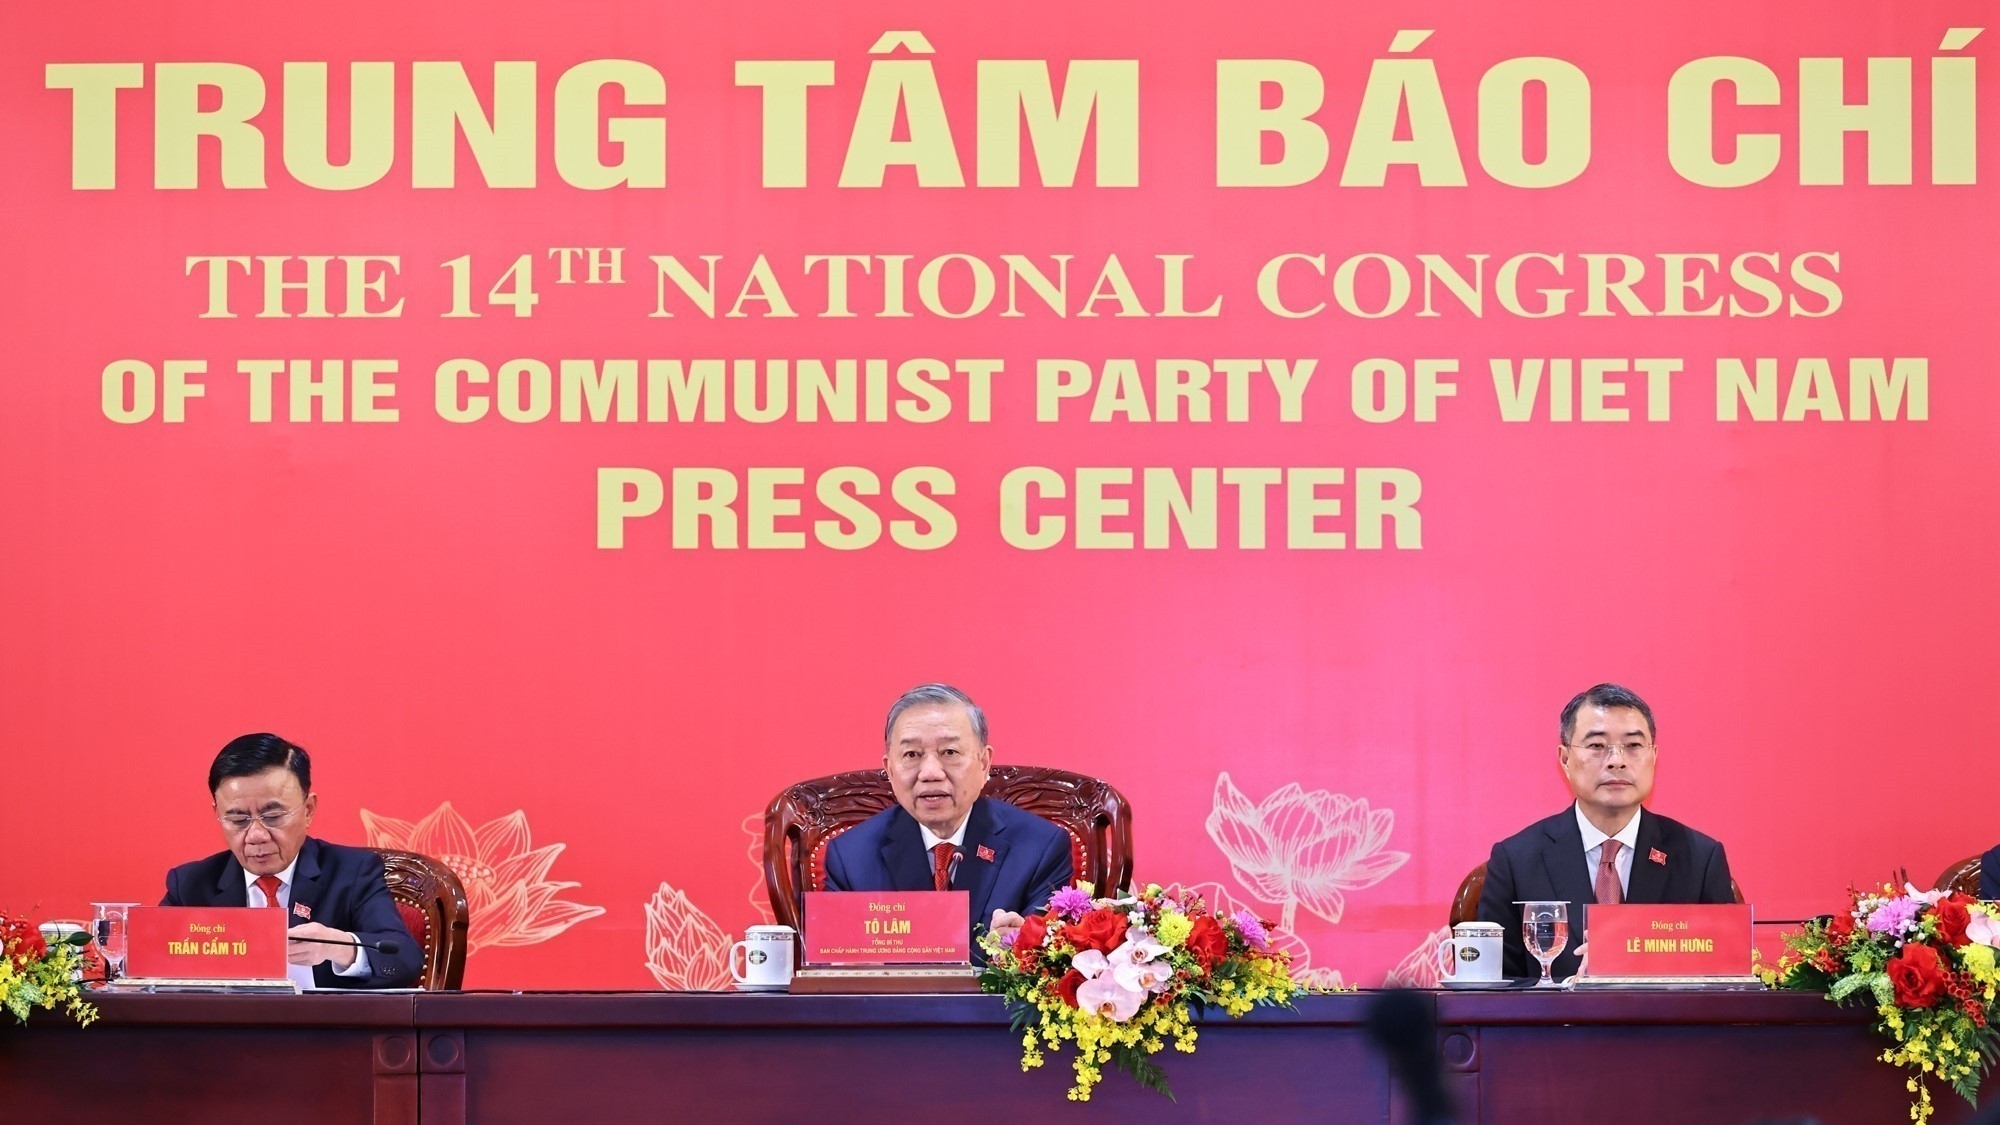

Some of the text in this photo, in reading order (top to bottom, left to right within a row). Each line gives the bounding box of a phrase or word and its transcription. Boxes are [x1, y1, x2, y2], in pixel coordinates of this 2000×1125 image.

[45, 28, 1985, 191] TRUNG TÂM BÁO CHÍ
[186, 255, 405, 319] THE
[649, 254, 1223, 319] NATIONAL
[1257, 253, 1844, 318] CONGRESS
[102, 358, 1929, 424] OF THE COMMUNIST PARTY OF VIET NAM
[597, 467, 1423, 550] PRESS CENTER
[893, 902, 906, 912] chí
[213, 923, 226, 933] chí
[864, 917, 911, 934] TÔ LÂM
[1675, 920, 1689, 930] chí
[202, 936, 229, 955] CẨM
[232, 939, 247, 955] TÚ
[1627, 936, 1713, 952] LÊ MINH HƯNG
